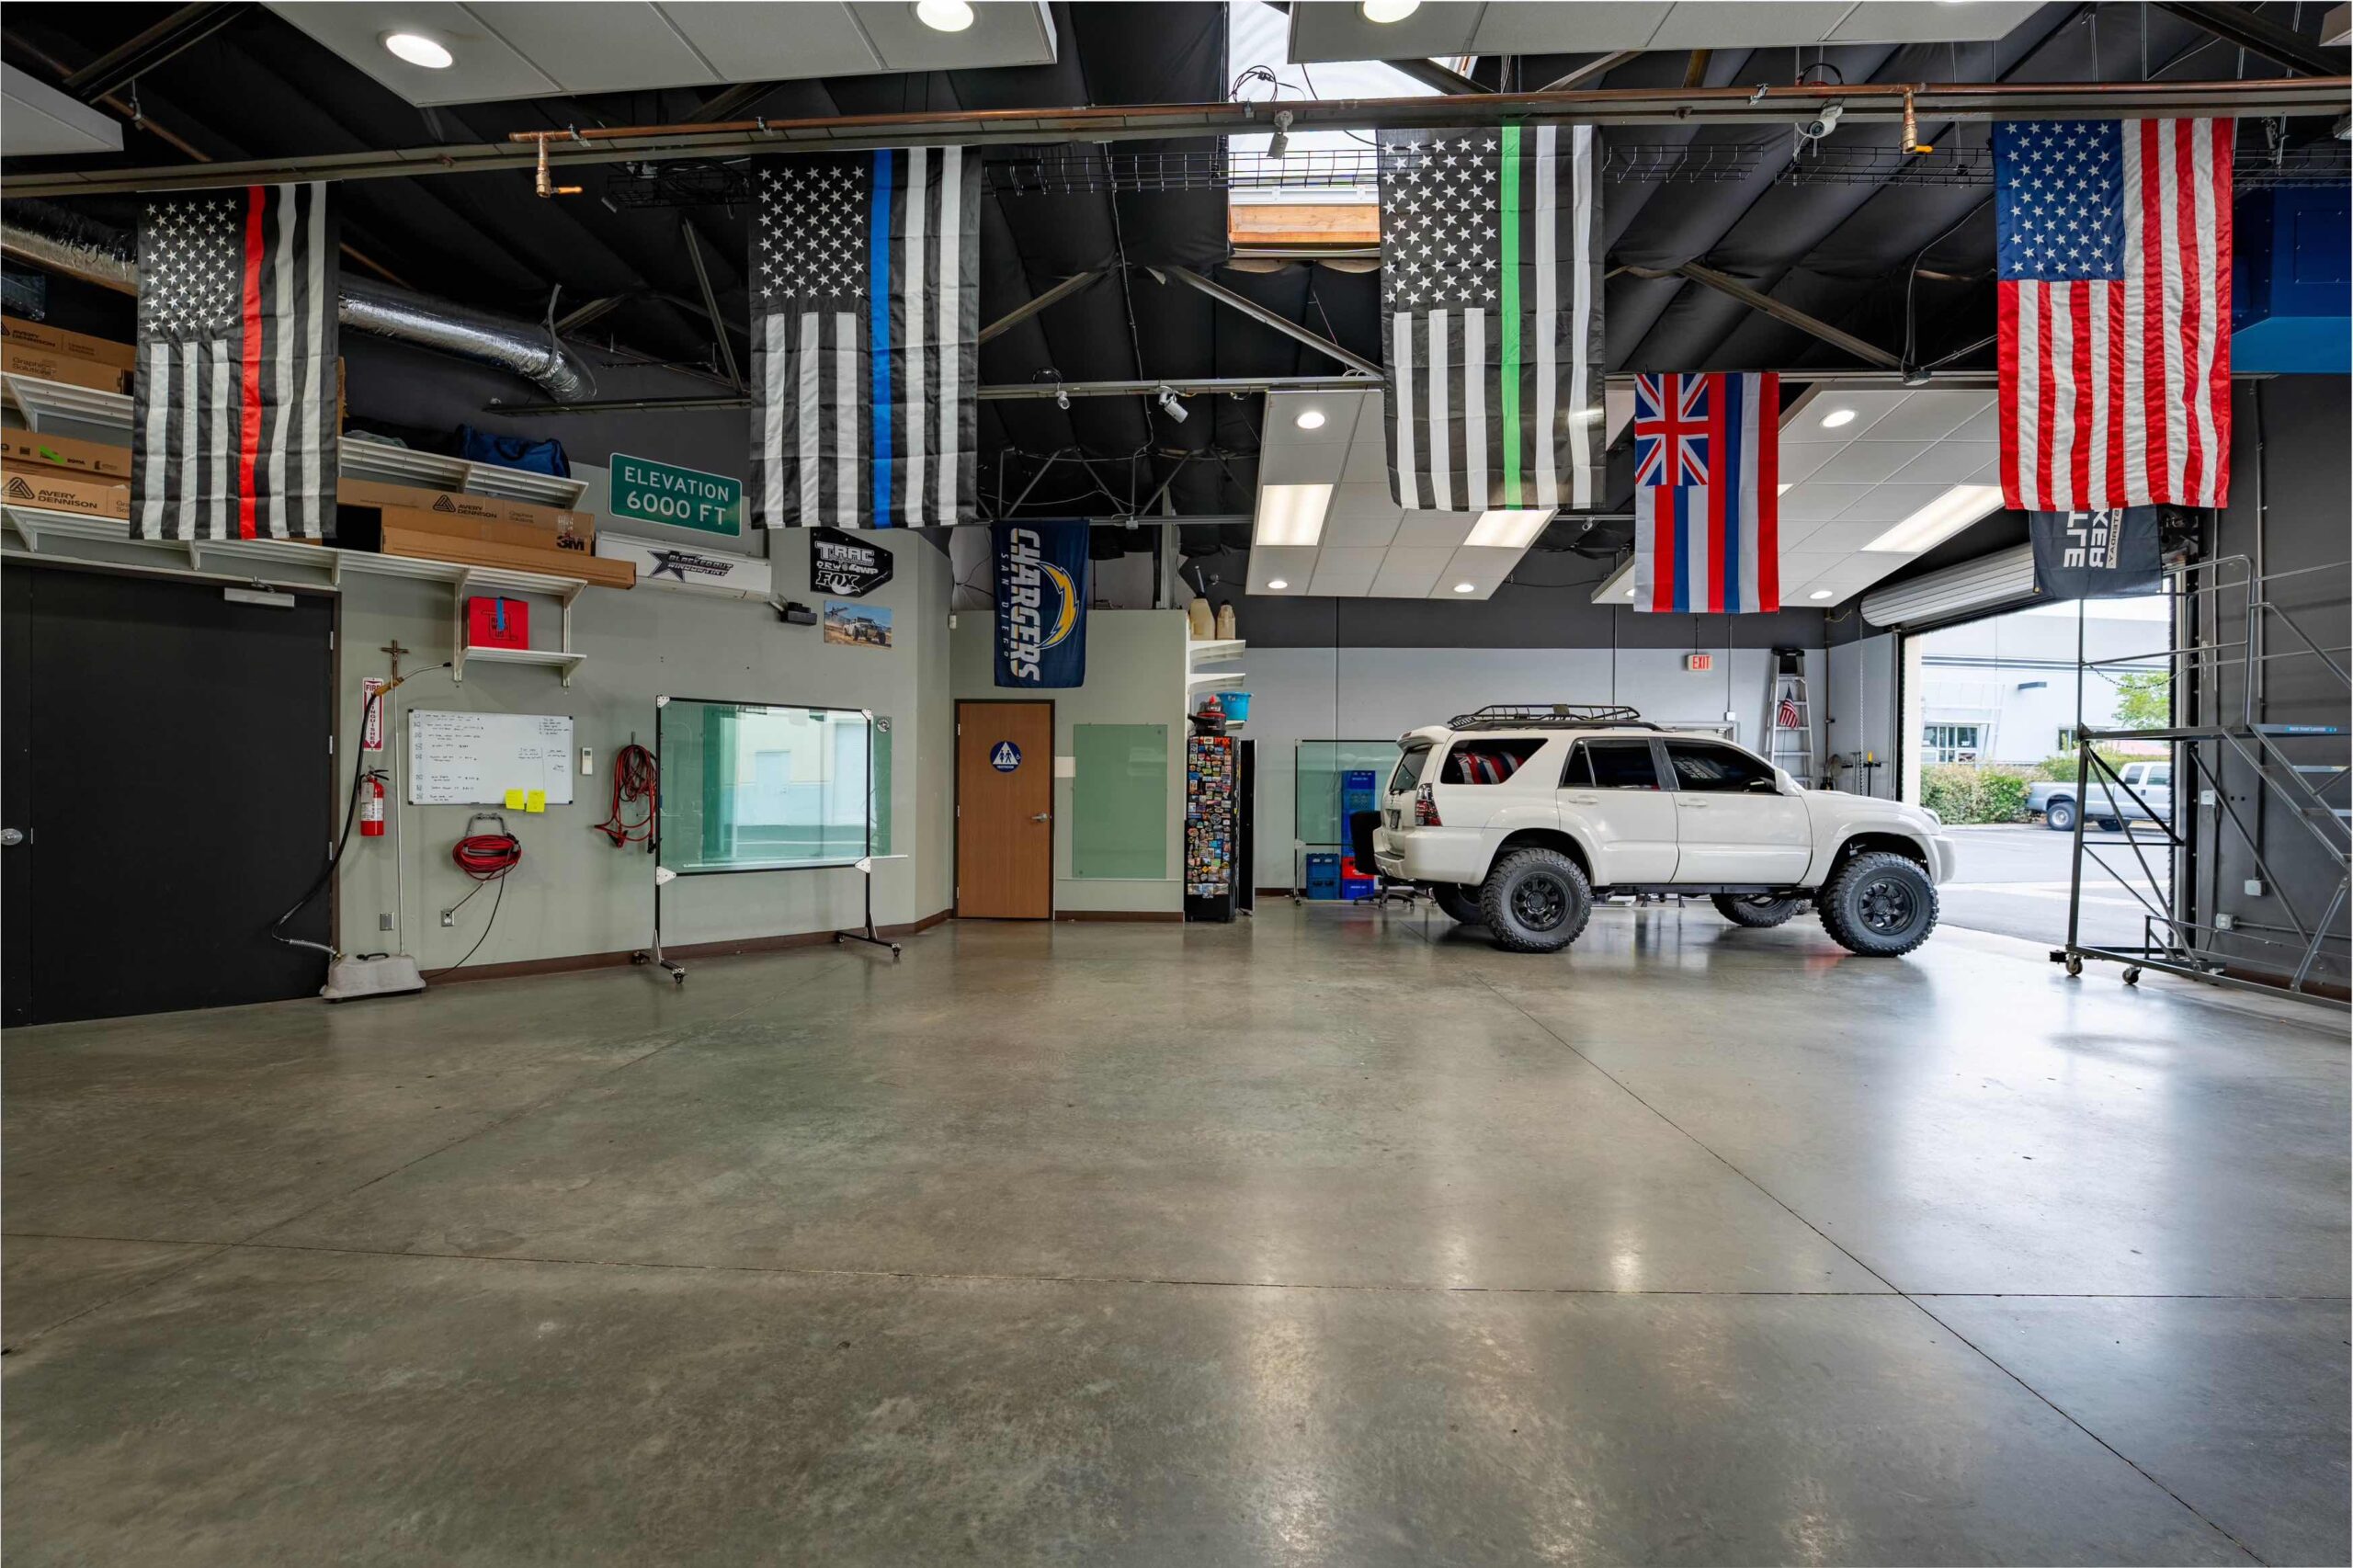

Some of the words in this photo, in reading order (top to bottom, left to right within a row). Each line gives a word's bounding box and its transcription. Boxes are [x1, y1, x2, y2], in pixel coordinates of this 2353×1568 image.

[39, 489, 75, 500] AVERY
[624, 466, 729, 502] ELEVATION
[38, 496, 97, 509] DENNISON
[457, 508, 498, 518] DENNISON
[626, 491, 691, 519] 6000
[699, 503, 727, 526] FT
[556, 535, 585, 551] 3M
[815, 541, 875, 565] TRAC
[1001, 552, 1009, 585] SAN
[815, 570, 860, 589] FOX
[1010, 528, 1040, 682] CHARGERS
[1001, 601, 1009, 658] DIEGO
[1692, 655, 1710, 670] EXIT
